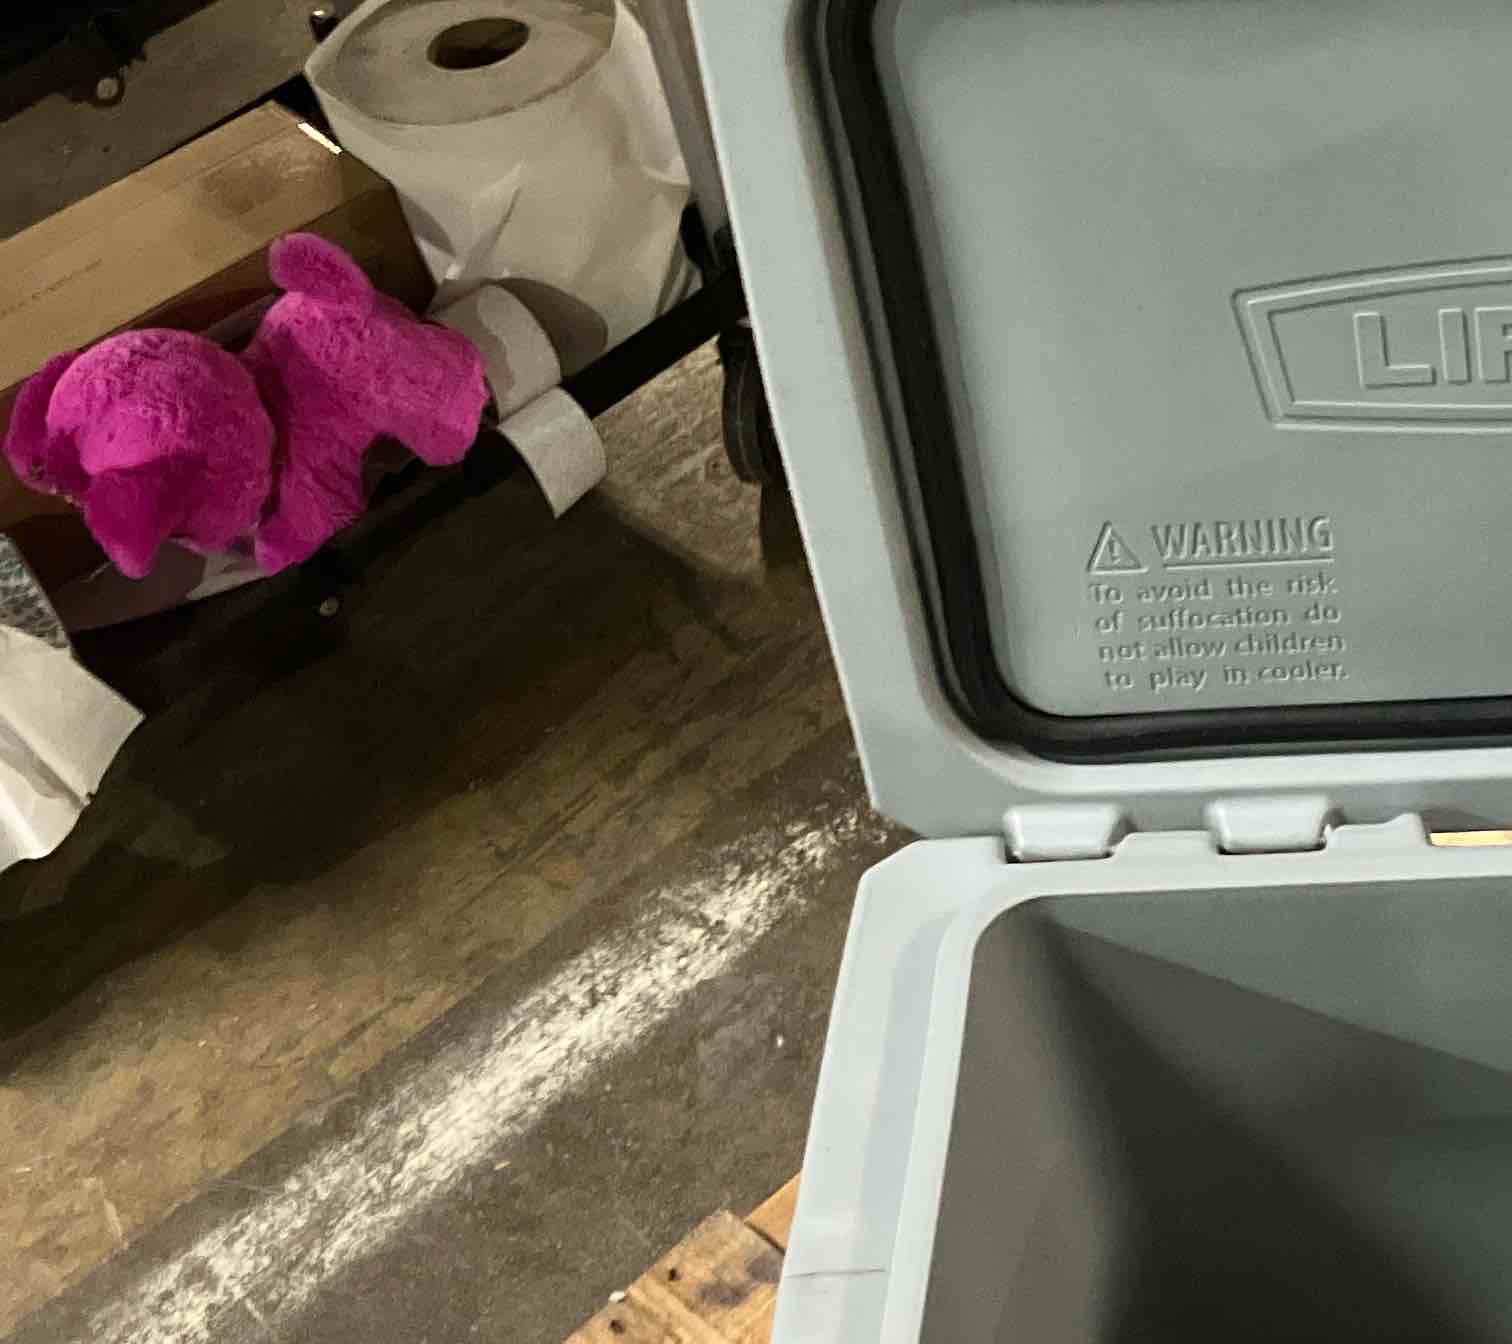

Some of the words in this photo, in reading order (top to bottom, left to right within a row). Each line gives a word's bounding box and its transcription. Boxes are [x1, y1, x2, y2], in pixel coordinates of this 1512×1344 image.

[1150, 515, 1336, 560] WARNING
[1089, 582, 1124, 605] To
[1137, 577, 1213, 603] avoid
[1227, 576, 1274, 600] the
[1287, 571, 1340, 596] risk
[1095, 610, 1124, 633] of
[1136, 605, 1291, 632] suffocation
[1303, 602, 1342, 624] do
[1100, 639, 1148, 663] not
[1153, 636, 1228, 661] allow
[1234, 631, 1347, 656] children
[1104, 668, 1135, 692] to
[1149, 666, 1209, 695] play
[1222, 664, 1249, 685] in
